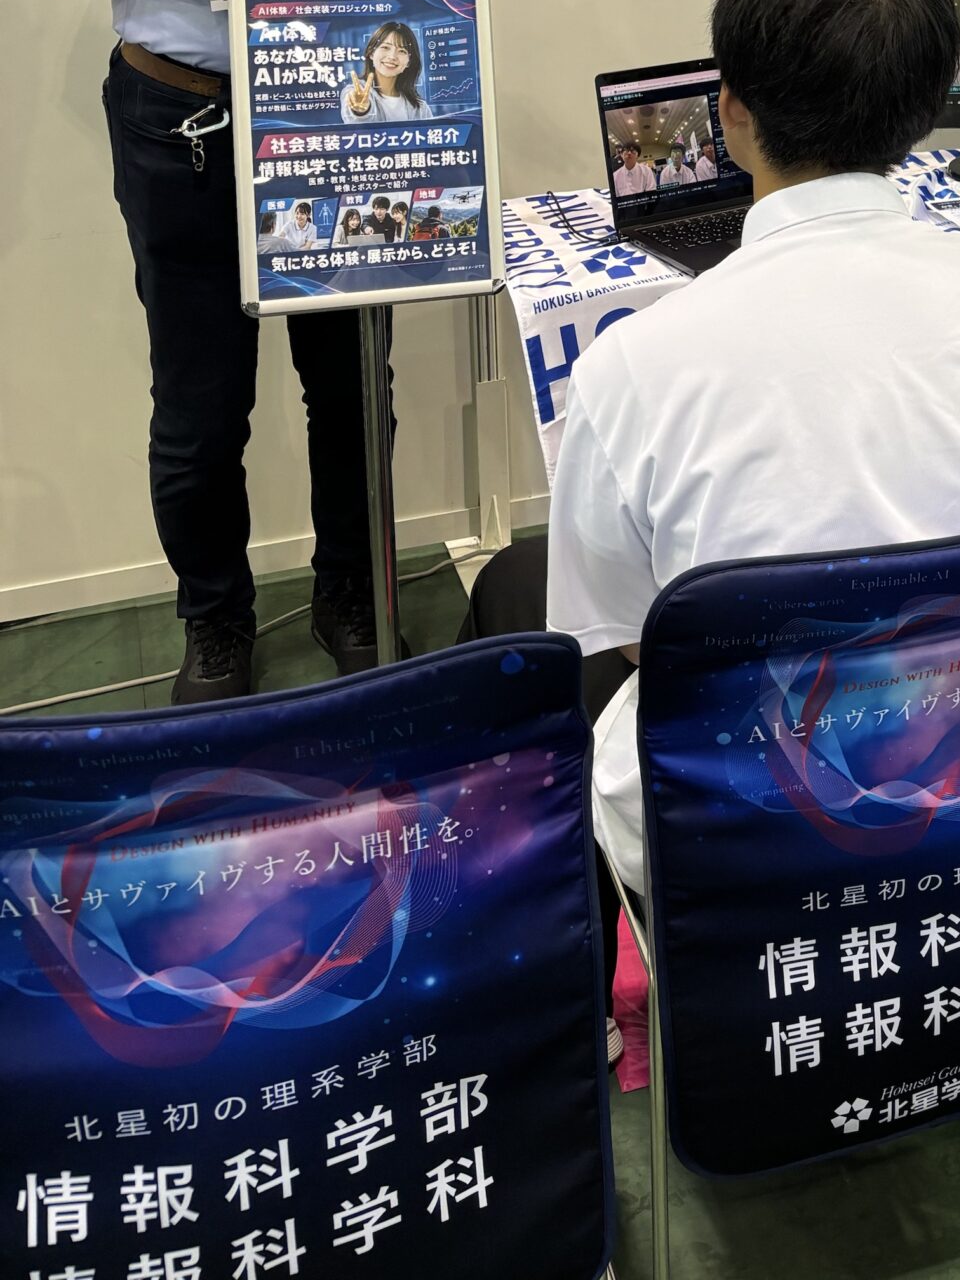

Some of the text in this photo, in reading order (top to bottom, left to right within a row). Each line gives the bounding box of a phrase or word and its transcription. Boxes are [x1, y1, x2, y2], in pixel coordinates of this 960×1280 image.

[270, 127, 460, 155] 社会実装プロジェクト紹介
[258, 149, 478, 178] 情報科学で、社会の課題に挑む！
[334, 180, 409, 193] 映像とポスターで紹介
[345, 195, 364, 205] 教育
[419, 189, 438, 199] 地域
[267, 200, 286, 211] 医療
[271, 240, 477, 273] 気になる体験・展示から、どうぞ！
[533, 291, 584, 315] HOKUSEI
[850, 573, 929, 592] Explainable
[0, 814, 477, 920] AIとサヴァイヴする人間性を。
[64, 1033, 438, 1143] 北星初の理系学部
[880, 1072, 936, 1101] Hokusei
[16, 1073, 490, 1248] 情報科学部
[29, 1145, 495, 1280] 報科学科
